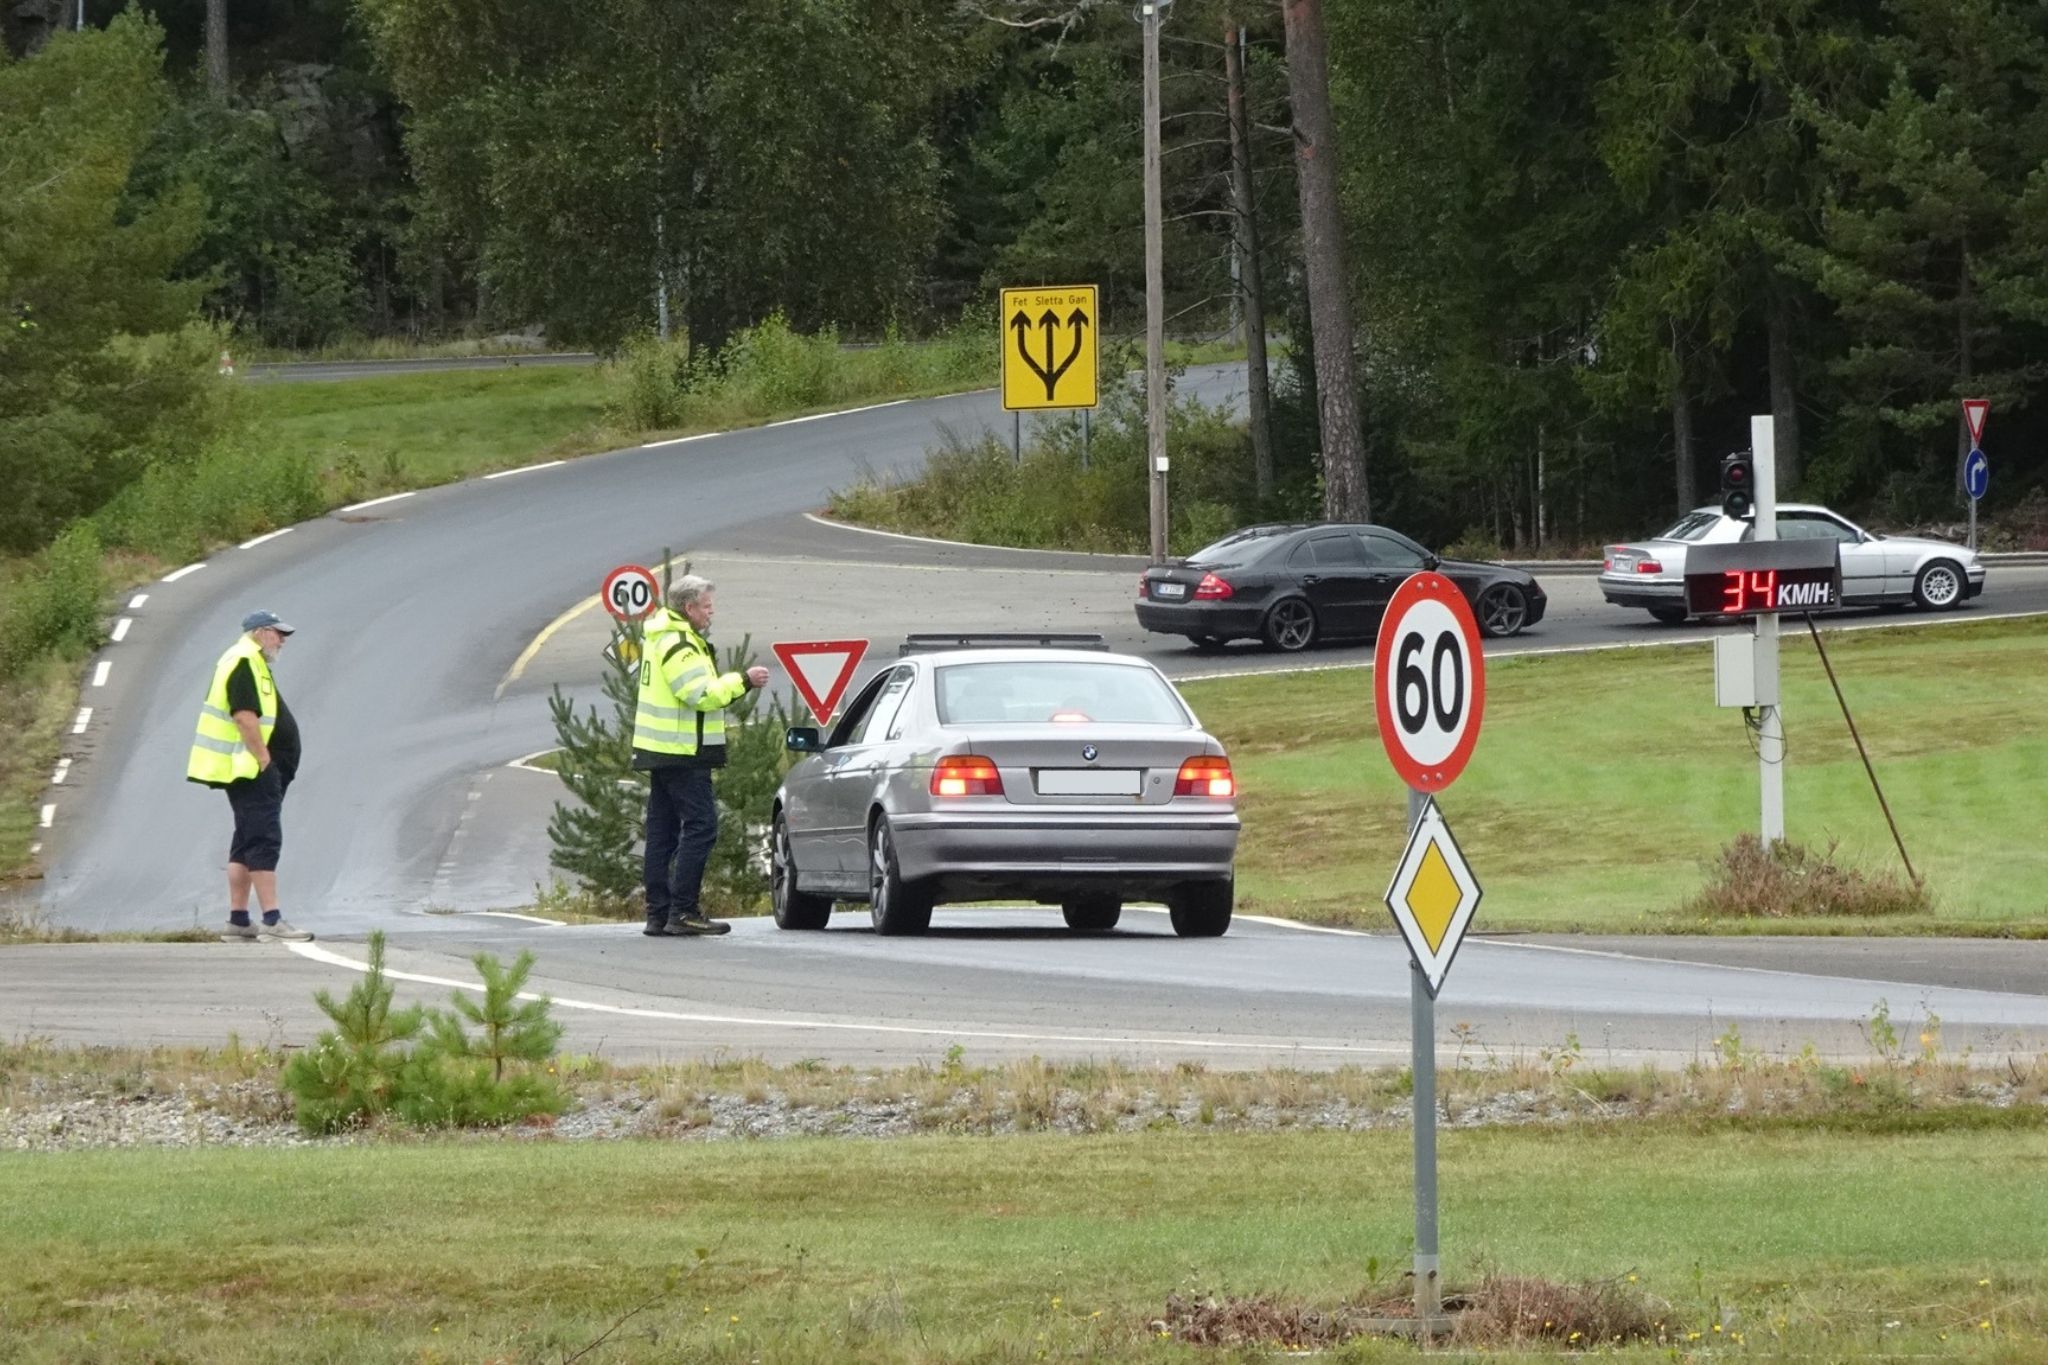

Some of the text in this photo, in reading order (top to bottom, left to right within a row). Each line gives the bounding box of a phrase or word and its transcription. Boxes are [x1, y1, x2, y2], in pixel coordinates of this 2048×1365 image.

[1012, 294, 1087, 306] Fet Sletta Gan
[612, 580, 649, 607] 60
[1723, 569, 1829, 613] 34 KM/H
[1396, 630, 1464, 735] 60
